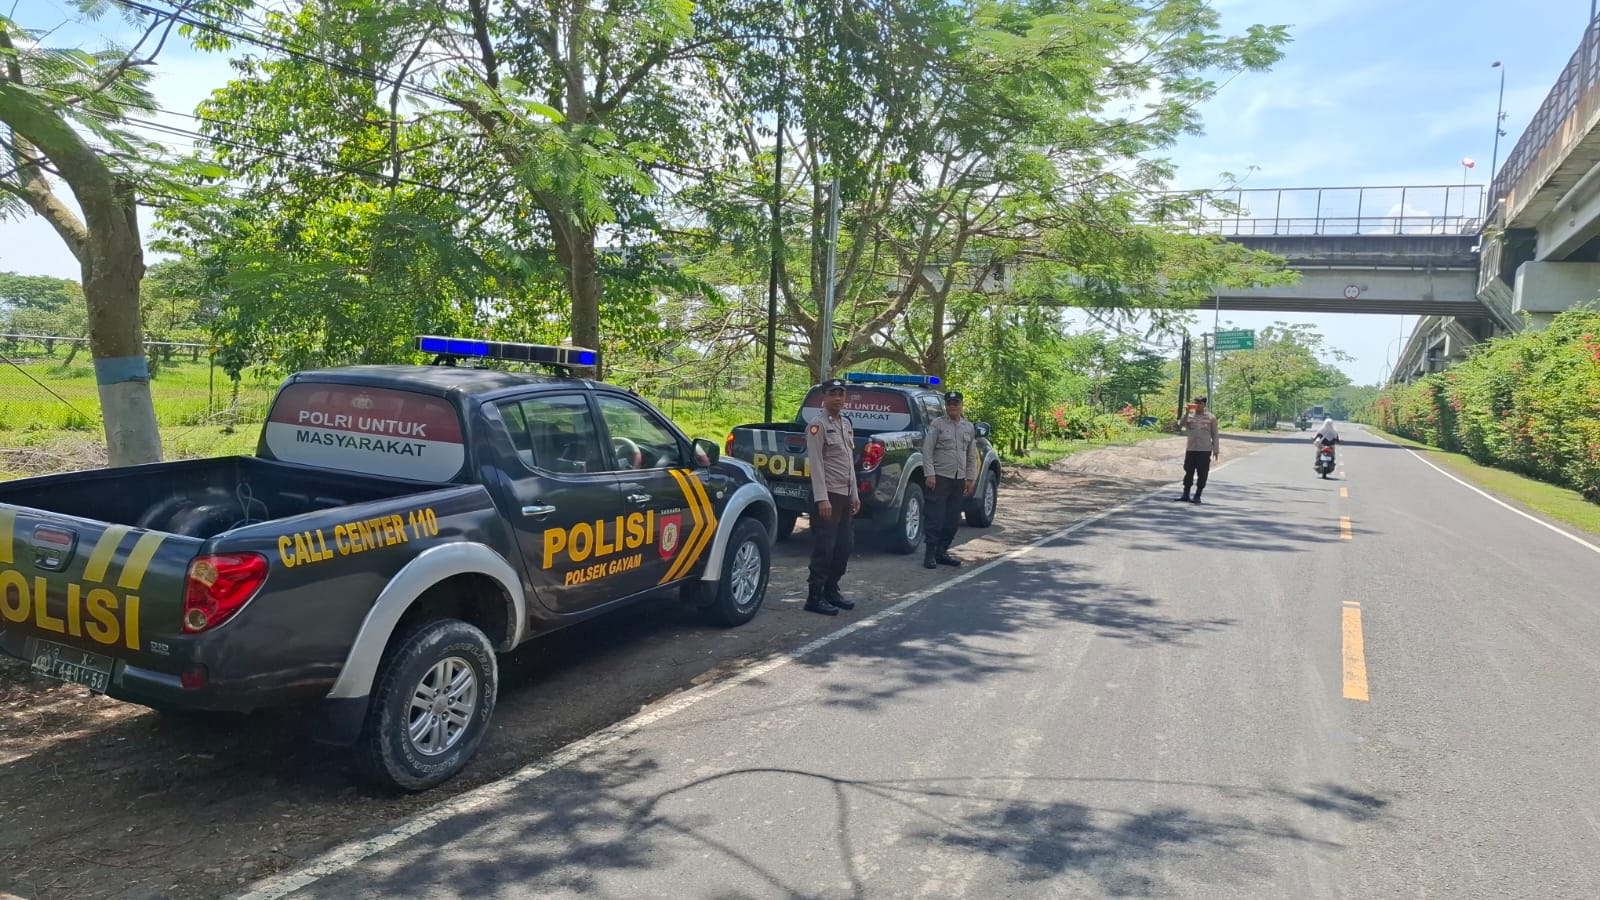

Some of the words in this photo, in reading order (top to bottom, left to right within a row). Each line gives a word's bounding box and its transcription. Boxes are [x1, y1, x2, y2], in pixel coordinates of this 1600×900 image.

[842, 411, 891, 421] YARAKAT
[855, 403, 892, 412] UNTUK
[299, 411, 352, 428] POLRI
[359, 417, 426, 437] UNTUK
[296, 430, 426, 457] MASYARAKAT
[278, 529, 333, 568] CALL
[334, 514, 408, 556] CENTER
[408, 507, 438, 540] 110
[542, 509, 654, 570] POLISI
[564, 564, 605, 587] POLSEK
[609, 554, 642, 576] GAYAM
